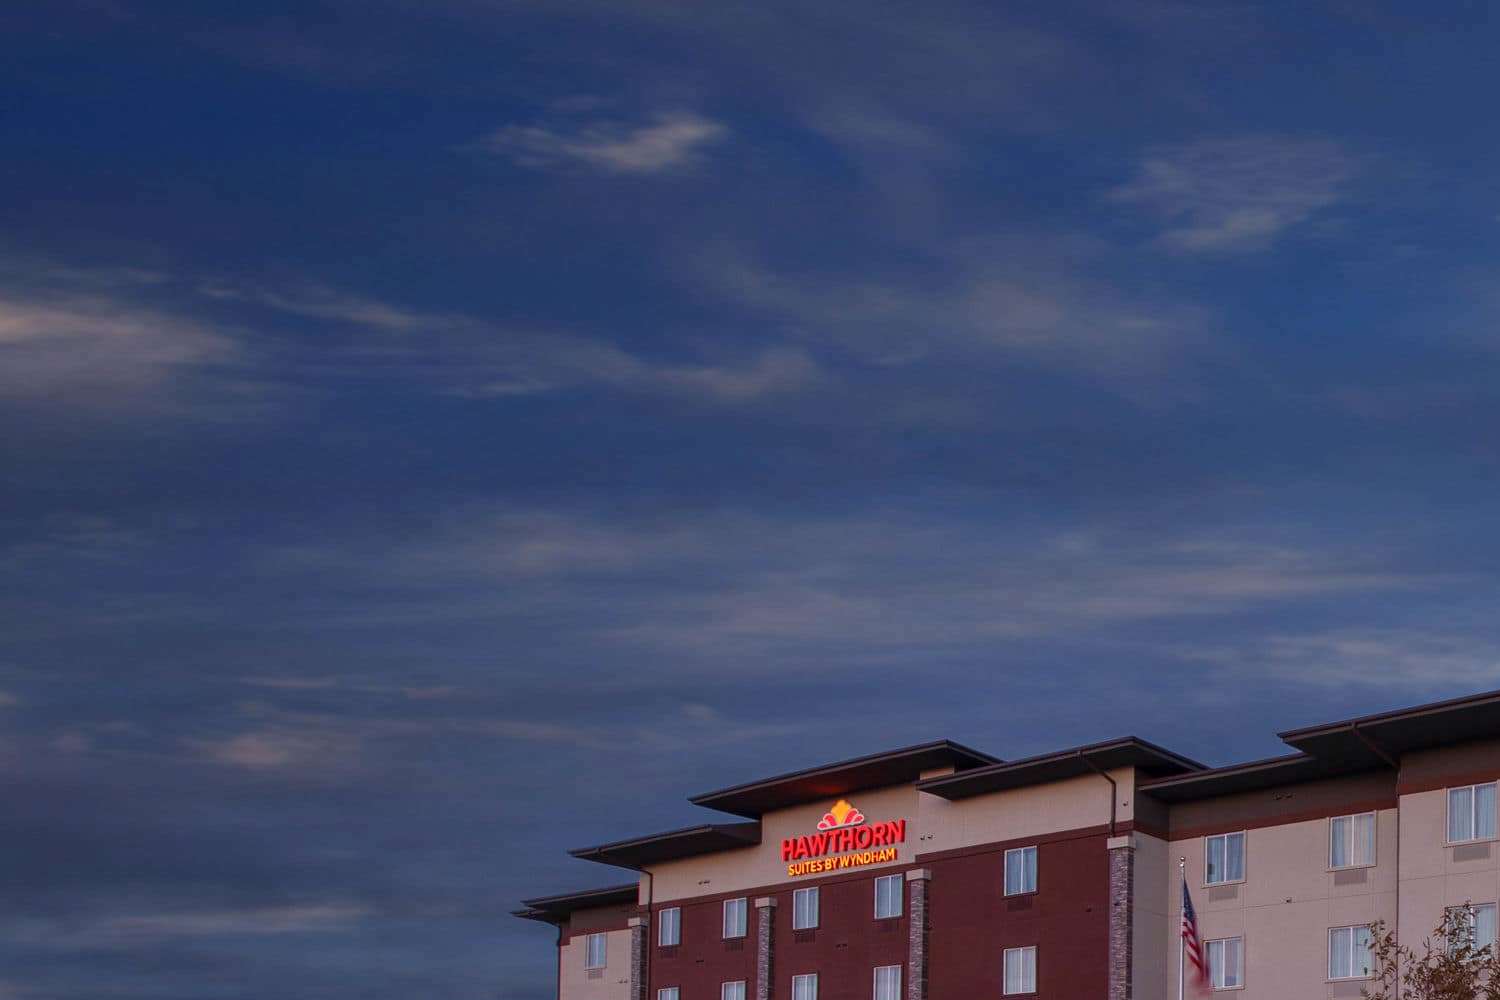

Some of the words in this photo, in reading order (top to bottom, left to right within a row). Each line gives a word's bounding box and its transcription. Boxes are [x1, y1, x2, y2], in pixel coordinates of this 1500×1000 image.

[782, 819, 905, 860] HAWTHORN
[788, 860, 823, 876] SUITES
[824, 858, 840, 870] BY
[840, 848, 896, 866] WYNDHAM
